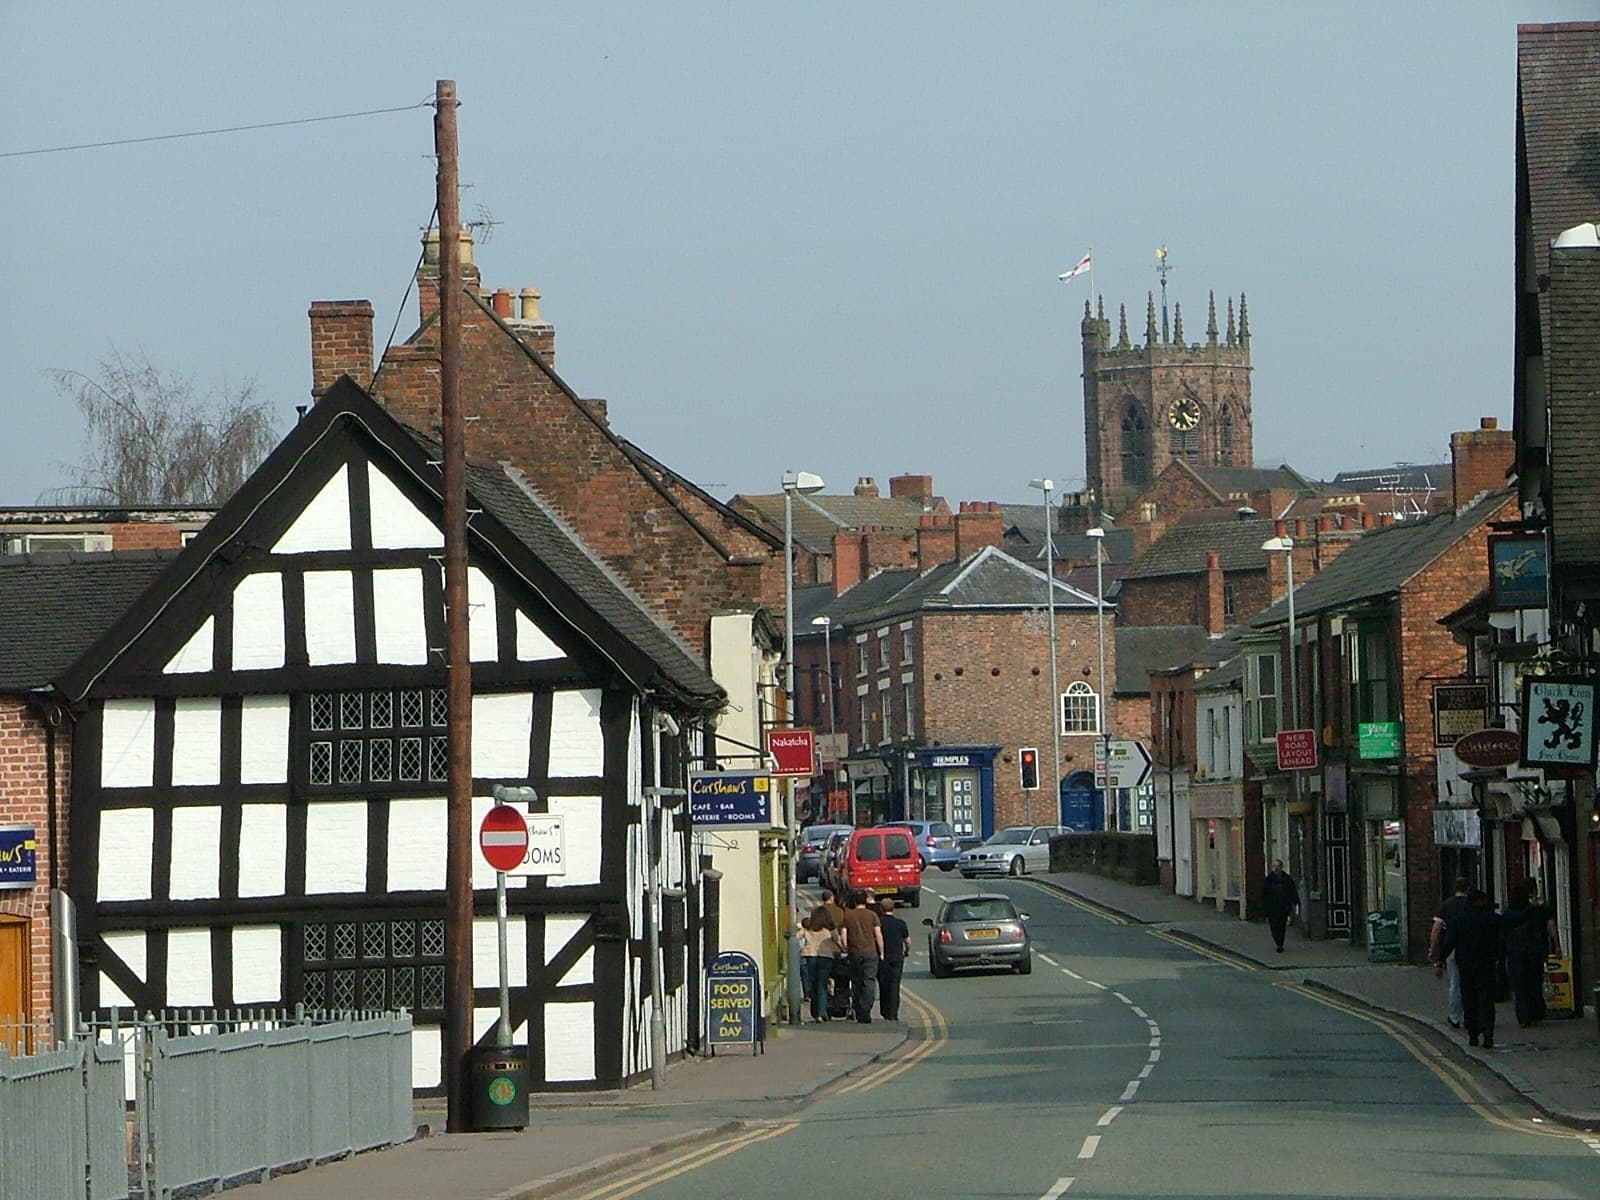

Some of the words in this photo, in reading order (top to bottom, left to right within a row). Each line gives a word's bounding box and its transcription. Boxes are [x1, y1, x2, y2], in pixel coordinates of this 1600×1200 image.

[1534, 684, 1563, 697] Black
[1568, 686, 1590, 699] Lion
[772, 736, 808, 747] Nakatcha
[1285, 742, 1308, 750] ROAD
[1281, 749, 1312, 758] LAYOUT
[934, 755, 969, 764] TEMPLES
[1283, 757, 1312, 766] AHEAD
[692, 813, 720, 821] EATERIE
[528, 824, 553, 836] shaws
[522, 847, 561, 864] OOMS
[714, 984, 748, 995] FOOD
[711, 998, 751, 1009] SERVED
[721, 1012, 742, 1023] ALL
[719, 1026, 742, 1037] DAY
